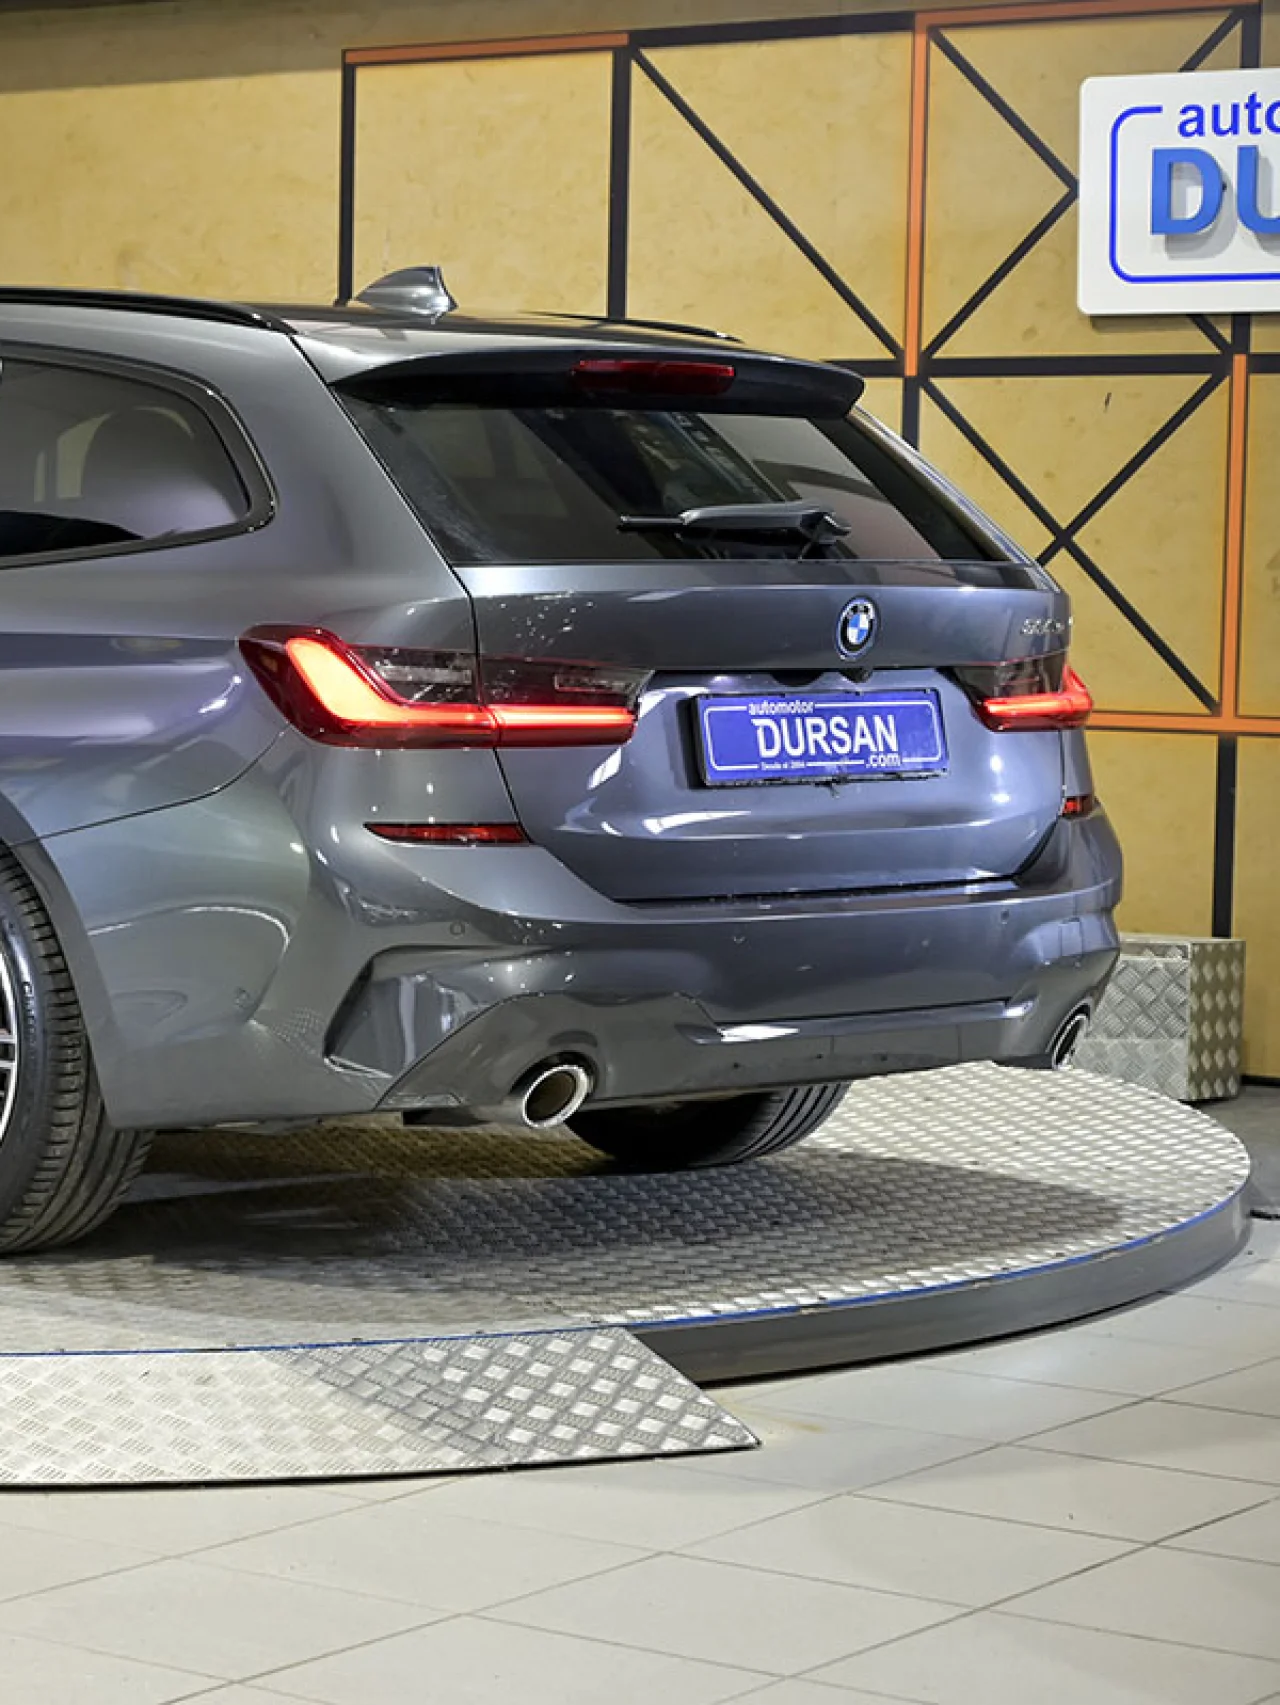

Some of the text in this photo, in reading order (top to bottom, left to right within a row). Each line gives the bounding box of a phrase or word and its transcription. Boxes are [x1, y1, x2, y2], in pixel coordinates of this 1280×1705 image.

[748, 701, 814, 716] automotor
[750, 714, 899, 758] DURSAN
[866, 752, 902, 768] .com
